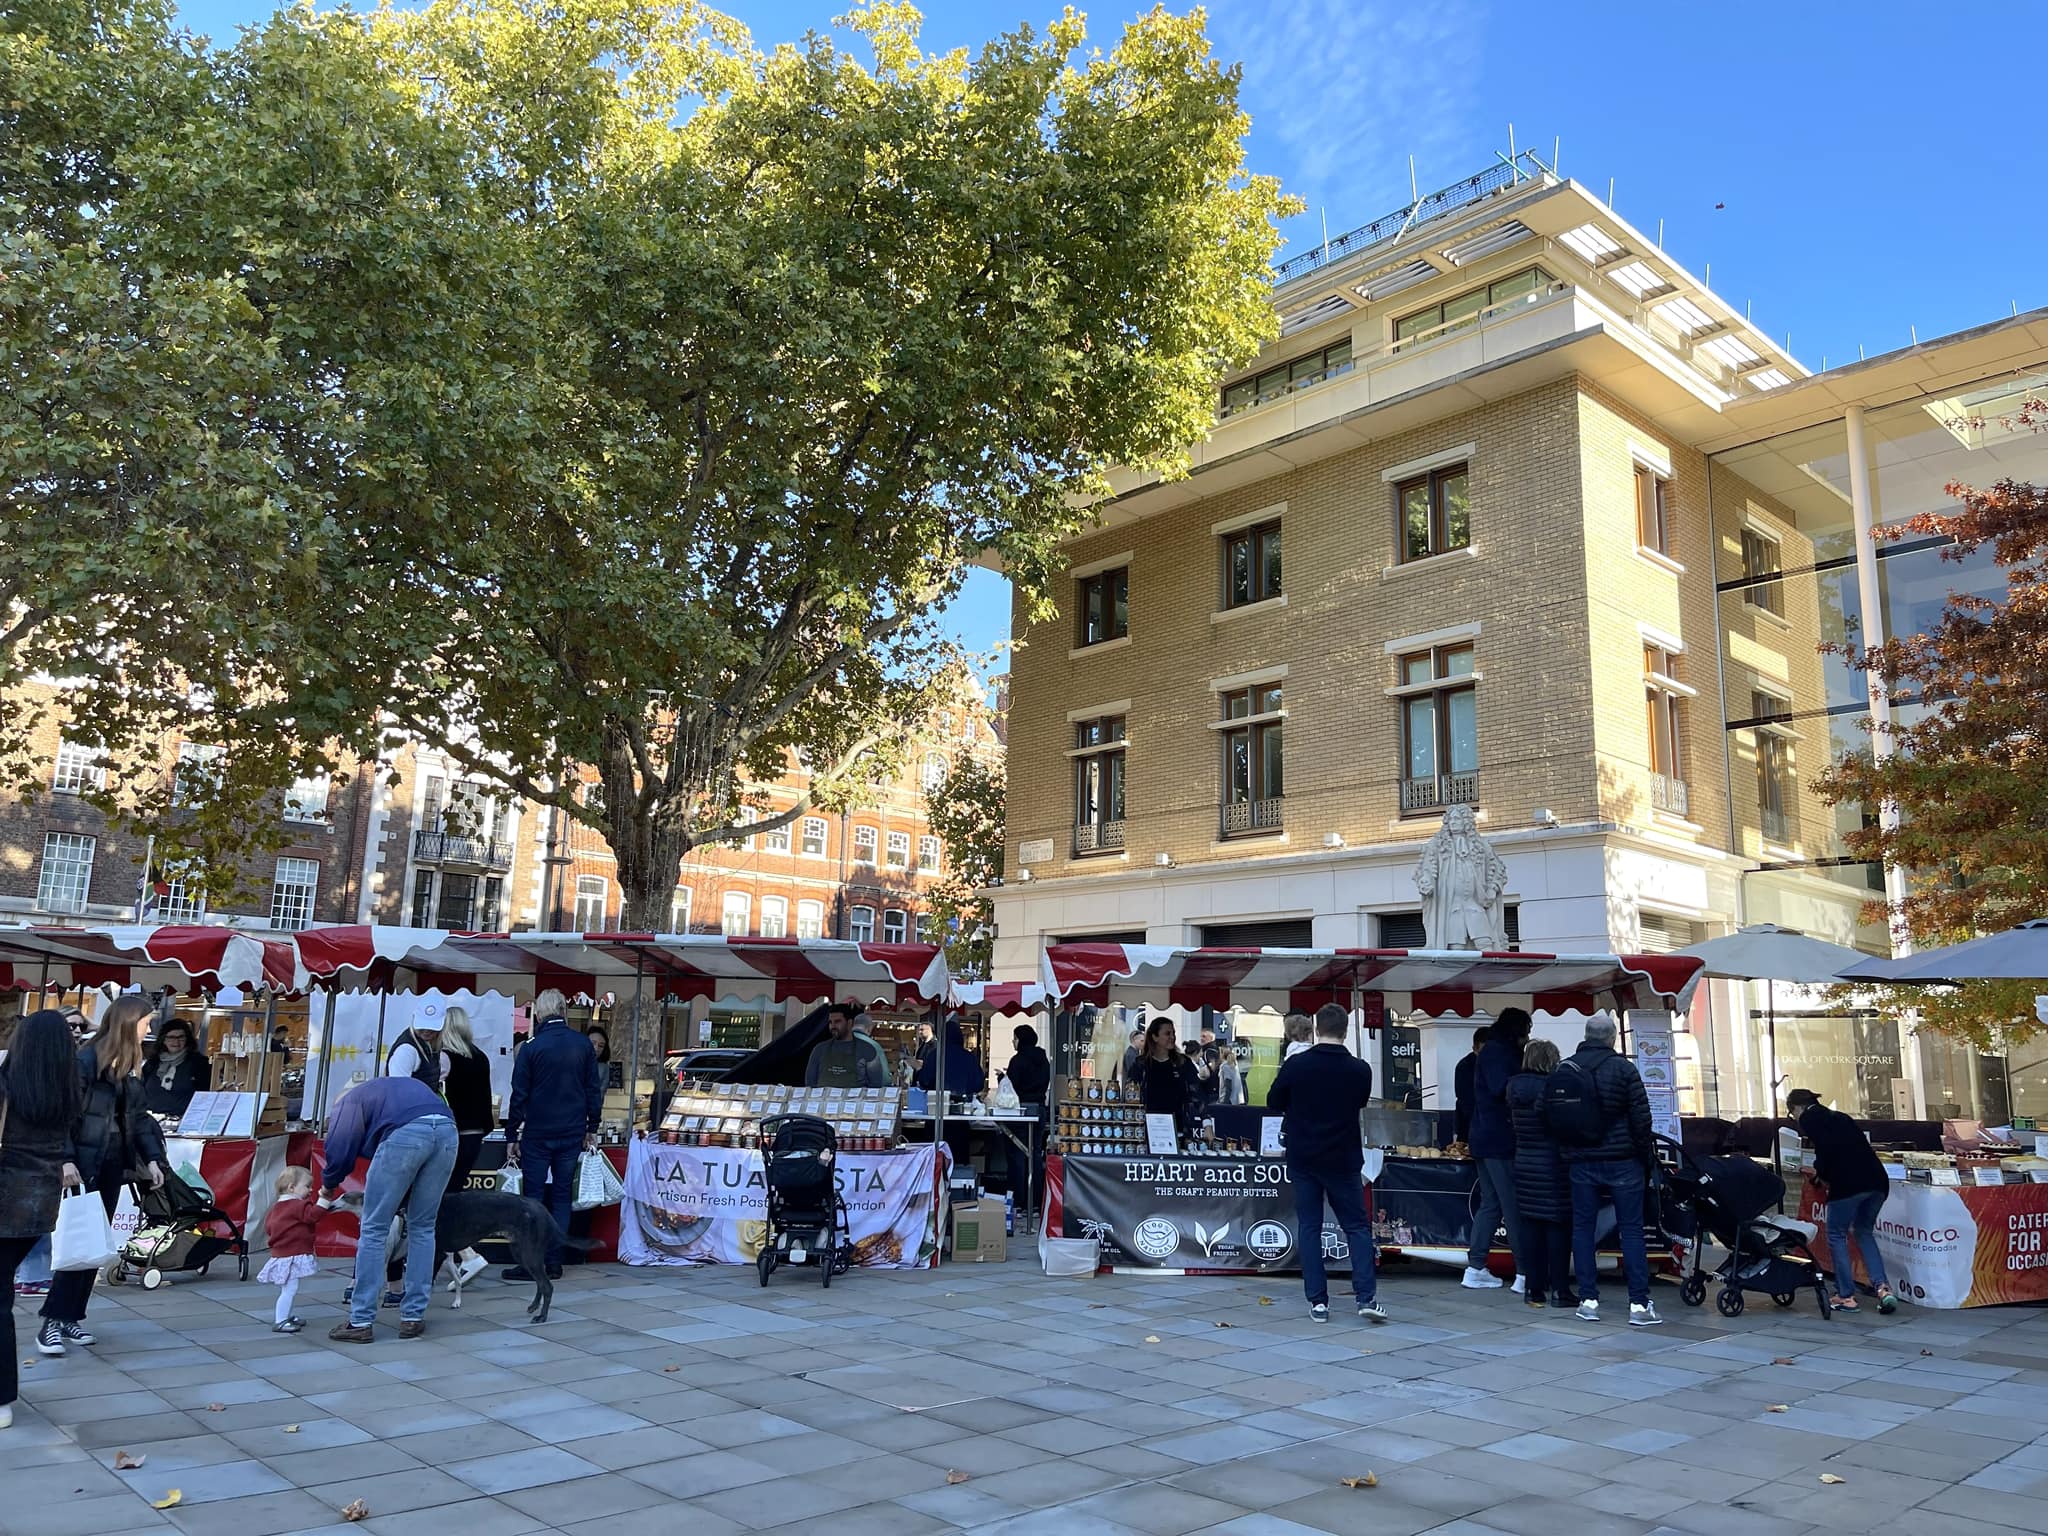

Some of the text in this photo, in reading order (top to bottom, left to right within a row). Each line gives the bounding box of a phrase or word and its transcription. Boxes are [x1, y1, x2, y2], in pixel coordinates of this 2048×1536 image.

[1825, 1055, 1852, 1065] YORK
[1854, 1055, 1895, 1066] SQUARE
[654, 1157, 687, 1185] LA
[702, 1162, 766, 1189] TUA
[833, 1167, 886, 1193] STA
[1124, 1162, 1291, 1184] HEART and SOU
[656, 1190, 886, 1211] rtisan Fresh Past ondon
[1154, 1186, 1279, 1198] THE CRAFT PEANUT BUTTER
[1140, 1239, 1175, 1255] NATURAL
[2008, 1230, 2041, 1253] FOR
